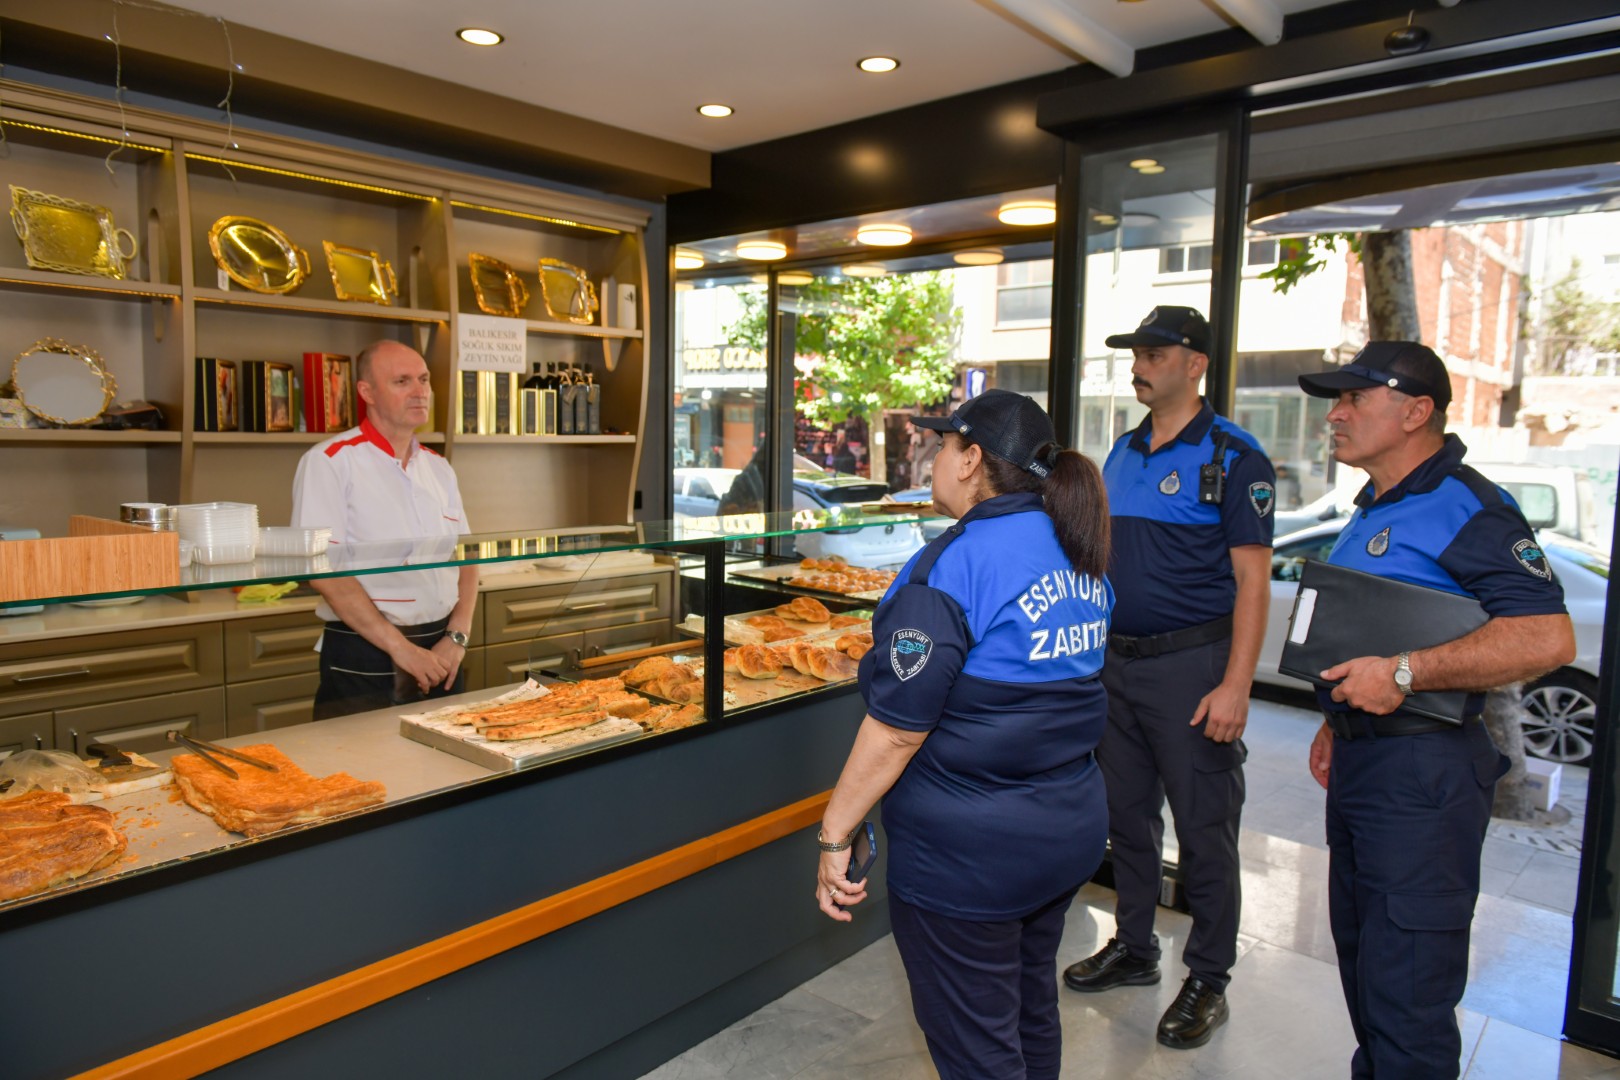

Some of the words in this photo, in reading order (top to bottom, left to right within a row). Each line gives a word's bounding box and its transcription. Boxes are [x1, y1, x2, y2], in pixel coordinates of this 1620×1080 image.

[468, 328, 518, 340] BALIKESİR
[462, 339, 495, 351] SOĞUK
[496, 342, 523, 353] SIKIM
[464, 352, 499, 363] ZEYTİN
[501, 354, 522, 365] YAĞI
[1030, 462, 1048, 478] ZABITA
[897, 631, 929, 645] ESENYURT
[1028, 618, 1107, 661] ZABITA
[906, 653, 927, 675] ZABITASI
